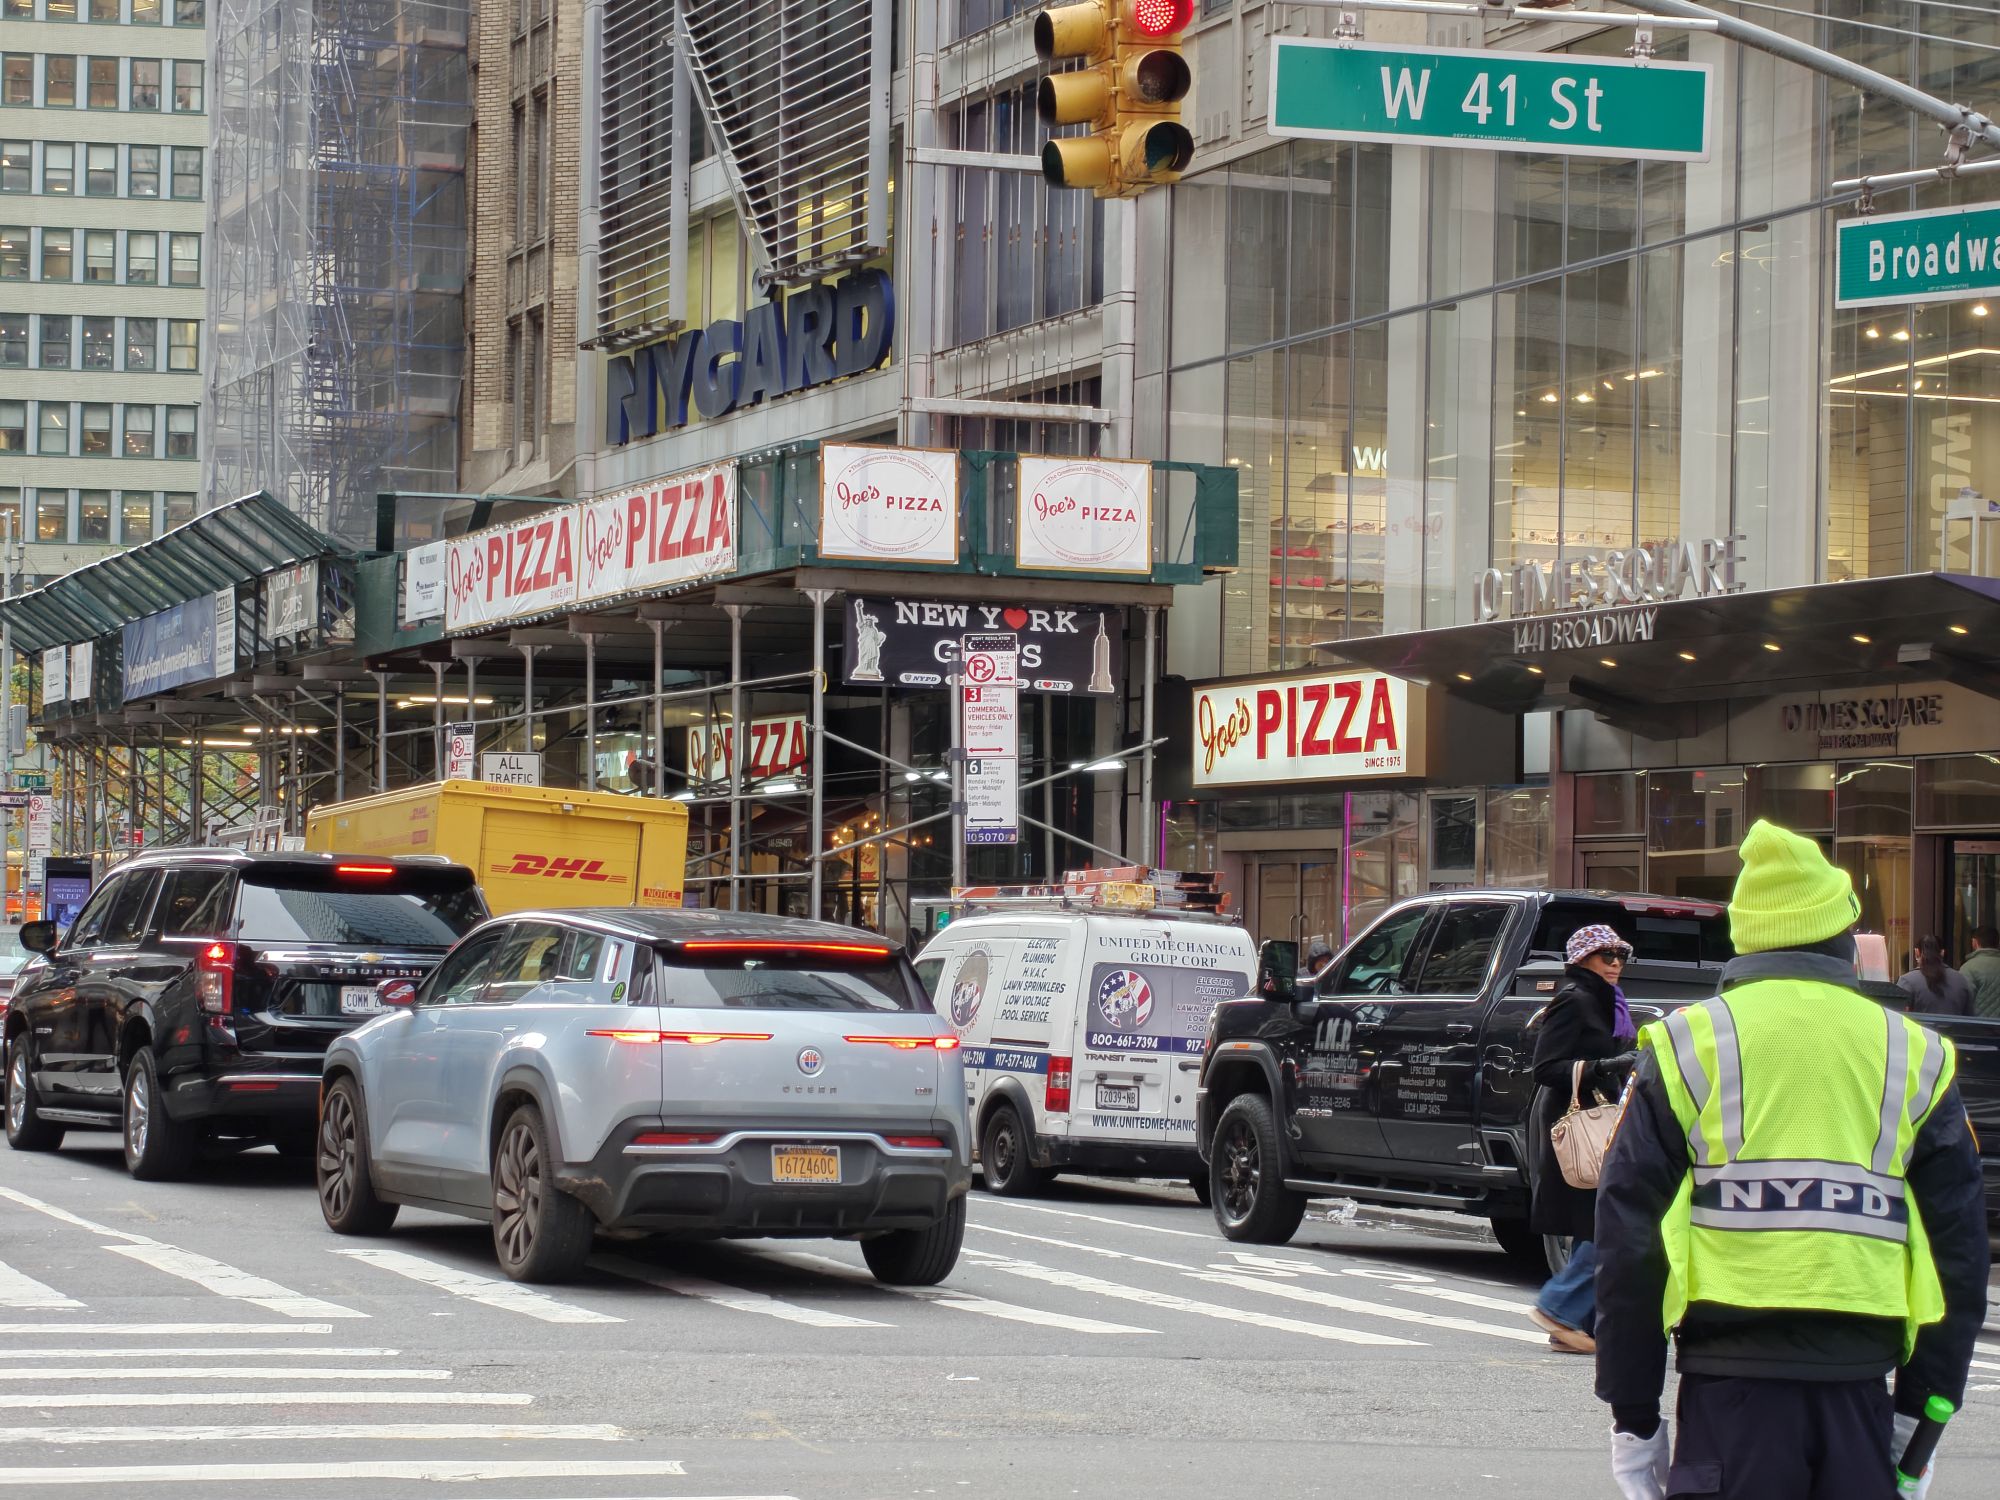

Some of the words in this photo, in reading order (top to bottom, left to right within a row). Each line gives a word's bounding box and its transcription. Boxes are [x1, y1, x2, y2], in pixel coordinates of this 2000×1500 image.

[1381, 67, 1431, 120] W
[1461, 73, 1517, 126] 41
[1549, 77, 1604, 133] St
[888, 454, 907, 463] Village
[1084, 466, 1102, 474] Village
[836, 481, 881, 510] Joe's
[885, 496, 943, 512] PIZZA
[1033, 492, 1076, 521] Joe's
[1081, 506, 1136, 522] PIZZA
[585, 507, 623, 590] Joe's
[625, 474, 731, 569] PIZZA
[450, 546, 484, 620] Joe's
[486, 516, 573, 602] PIZZA
[1511, 554, 1598, 615] TIMES
[1603, 535, 1747, 603] SQUARE
[275, 573, 290, 593] NEW
[895, 601, 969, 628] NEW
[1512, 620, 1545, 654] 1441
[1551, 608, 1659, 650] BROADWAY
[912, 675, 938, 683] NYPD
[968, 688, 978, 702] 3
[1860, 694, 1944, 729] SQUARE
[1198, 694, 1252, 775] Joe's
[1256, 677, 1399, 760] PIZZA
[724, 720, 808, 778] PZZA
[499, 756, 524, 770] ALL
[969, 760, 979, 774] 6
[1364, 757, 1385, 768] SINCE
[1386, 756, 1401, 767] 1975
[489, 773, 534, 784] TRAFFIC
[484, 785, 513, 794] H48516
[966, 832, 1005, 842] 105070
[509, 854, 610, 881] DHL
[646, 889, 677, 899] NOTICE
[1027, 939, 1060, 950] ELECTRIC
[1099, 936, 1151, 949] UNITED
[1155, 939, 1245, 957] MECHANICAL
[1021, 953, 1057, 964] PLUMBING
[1130, 952, 1178, 964] GROUP
[320, 968, 423, 977] SUBURBAN
[1002, 981, 1023, 992] LAWN
[1023, 982, 1066, 994] SPRINKLERS
[1196, 976, 1234, 987] ELECTRIC
[1195, 986, 1236, 997] PLUMBING
[346, 993, 369, 1008] COMM
[1004, 995, 1020, 1005] LOW
[1021, 996, 1052, 1007] VOLTAGE
[1000, 1010, 1019, 1020] POOL
[1020, 1011, 1050, 1022] SERVICE
[1091, 1033, 1159, 1049] 800-661-7394
[995, 1052, 1038, 1070] 917-577-1634
[1084, 1053, 1126, 1062] TRANSIT
[778, 1156, 834, 1175] T672460C
[1719, 1179, 1890, 1217] NYPD
